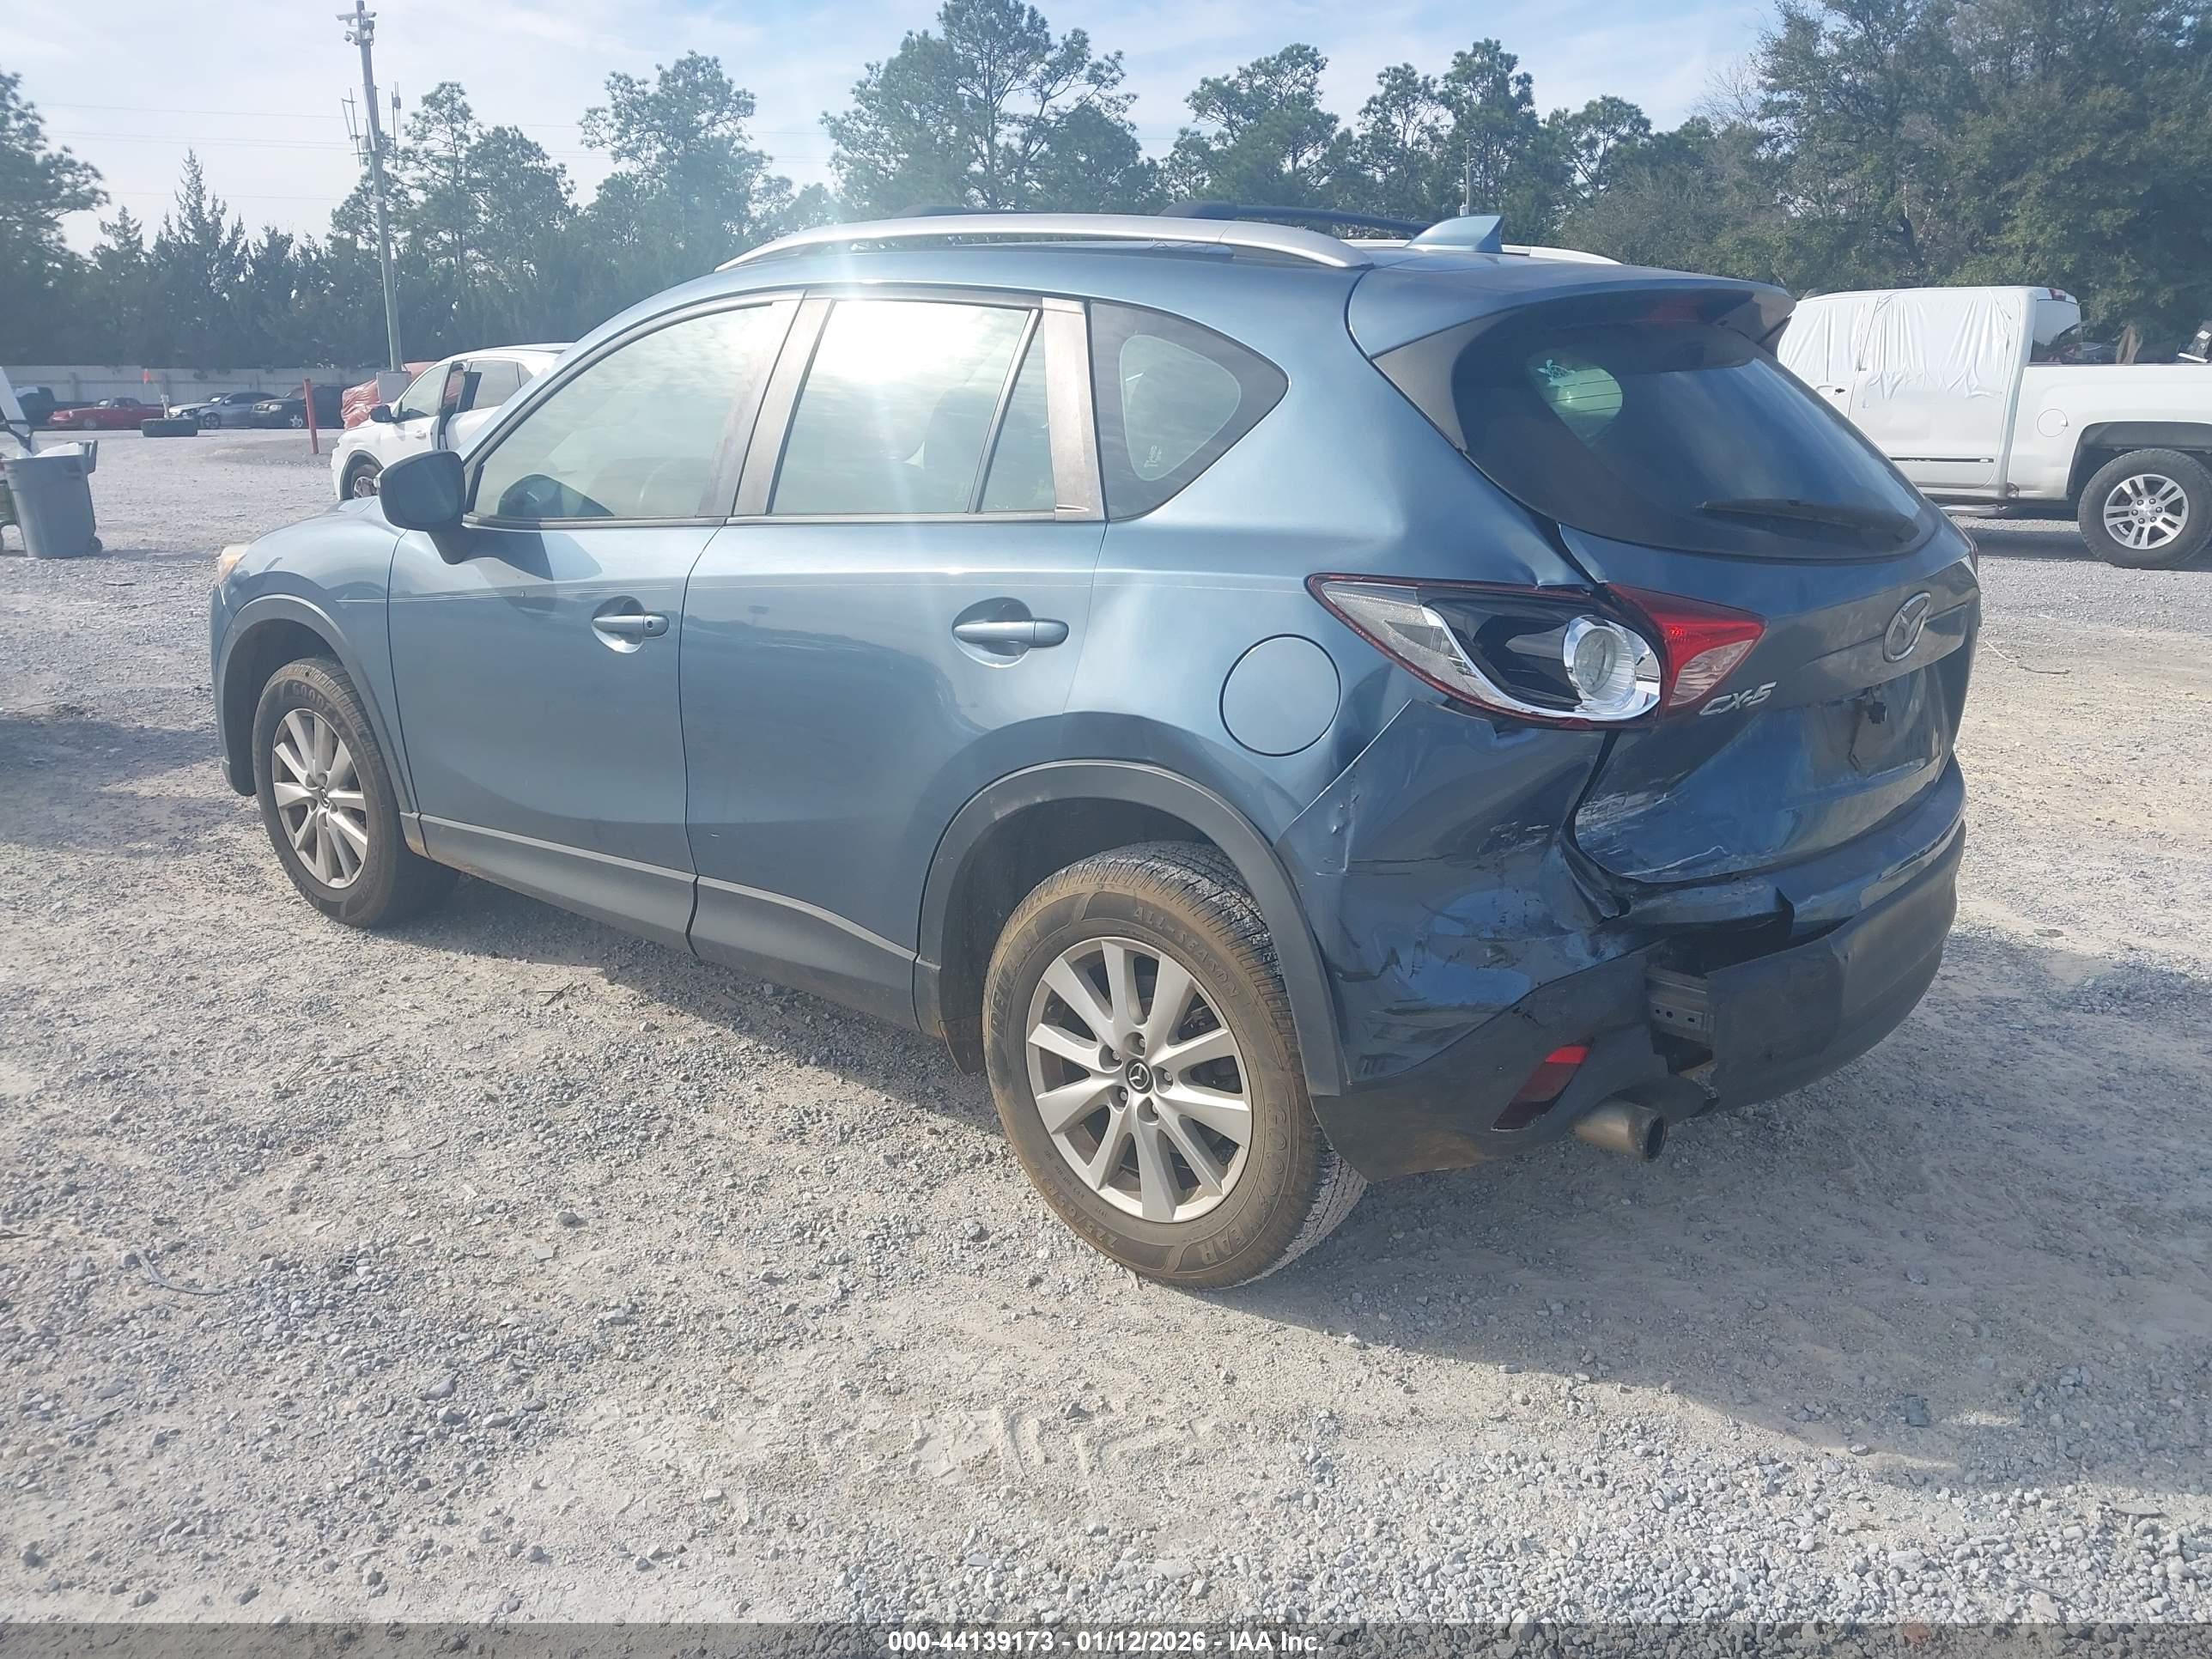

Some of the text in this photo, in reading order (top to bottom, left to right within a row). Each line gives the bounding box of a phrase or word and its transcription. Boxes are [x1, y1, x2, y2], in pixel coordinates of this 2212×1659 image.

[1699, 681, 1778, 715] CX-5
[1133, 905, 1239, 999] ALL-SEASON
[1200, 1102, 1288, 1266] GOODYEAR
